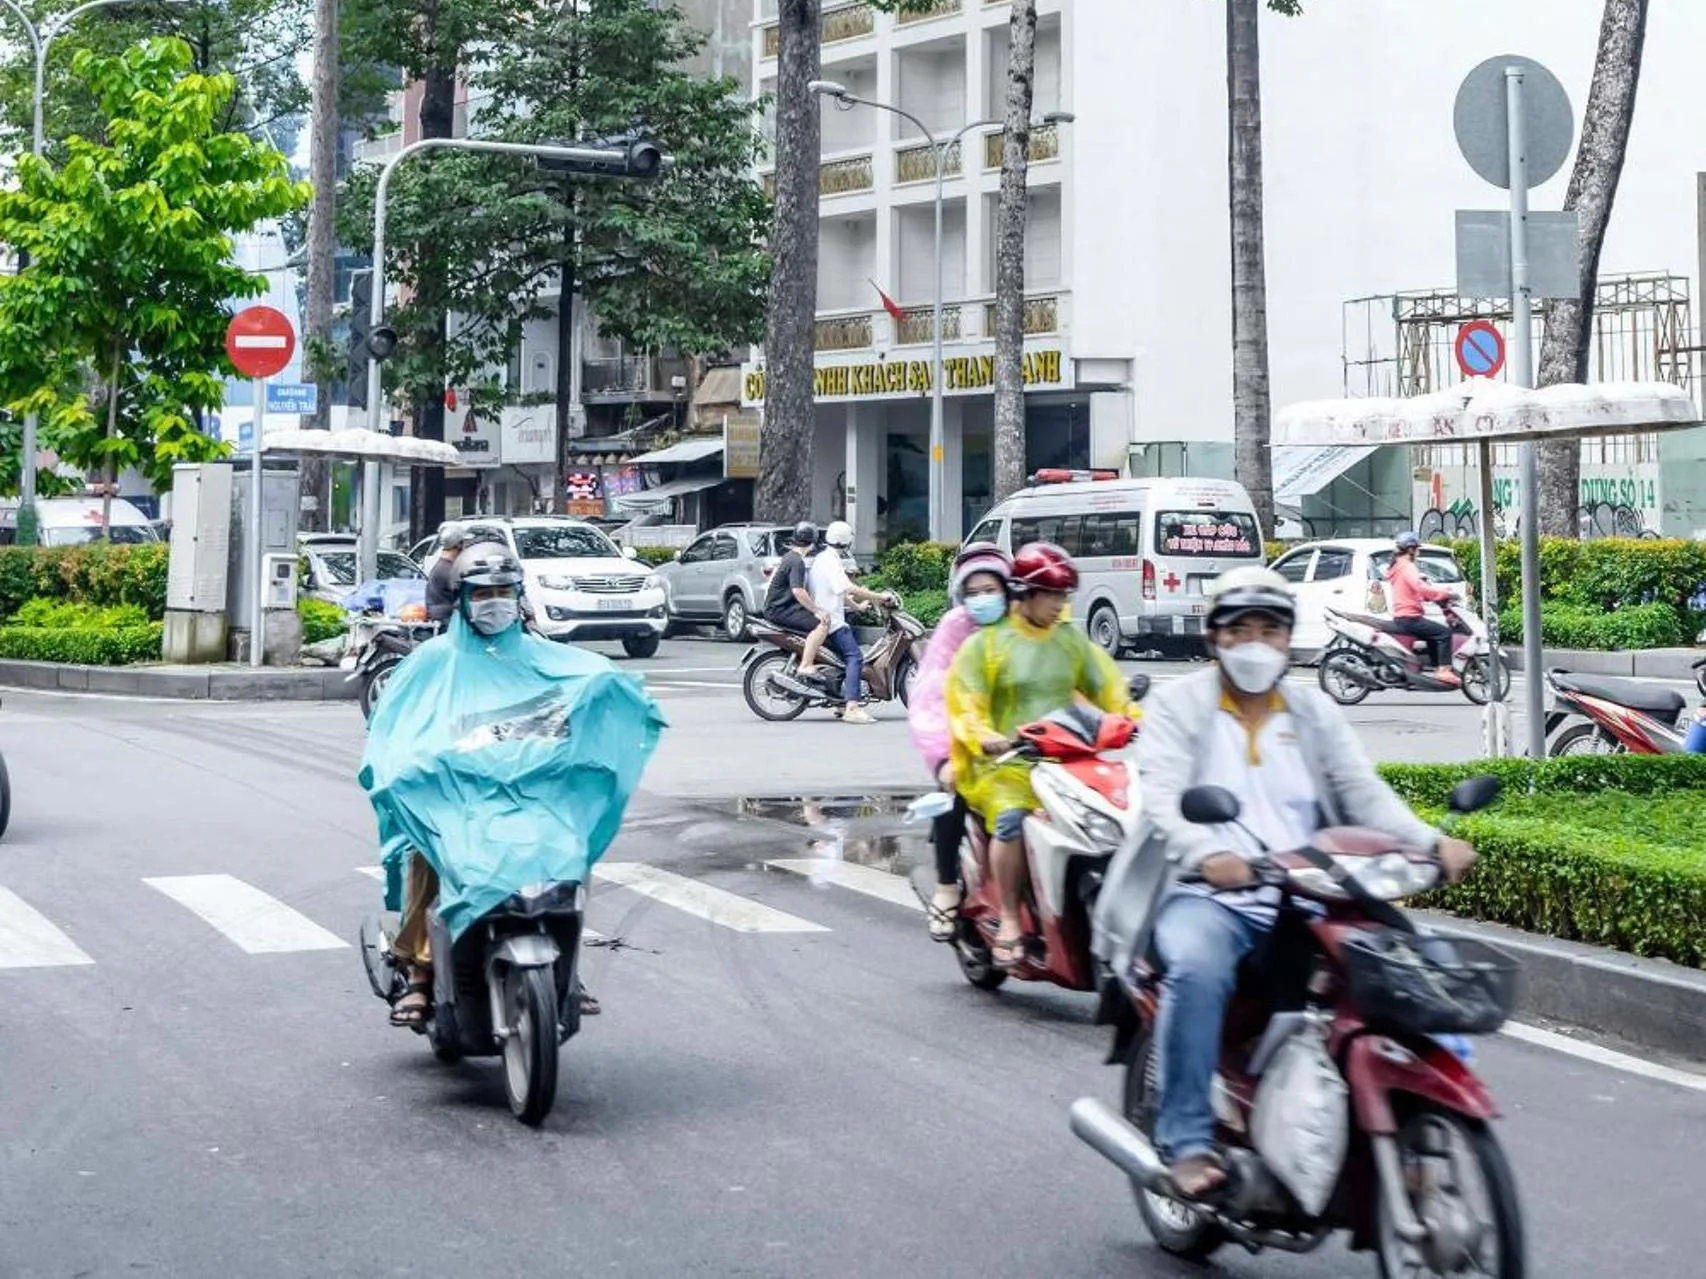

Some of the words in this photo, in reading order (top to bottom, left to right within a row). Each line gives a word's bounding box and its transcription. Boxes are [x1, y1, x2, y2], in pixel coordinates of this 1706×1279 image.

[815, 367, 849, 396] NHH
[908, 360, 935, 397] SẠ
[943, 355, 994, 389] THAN
[1022, 351, 1062, 384] ANH
[1639, 478, 1656, 509] 14
